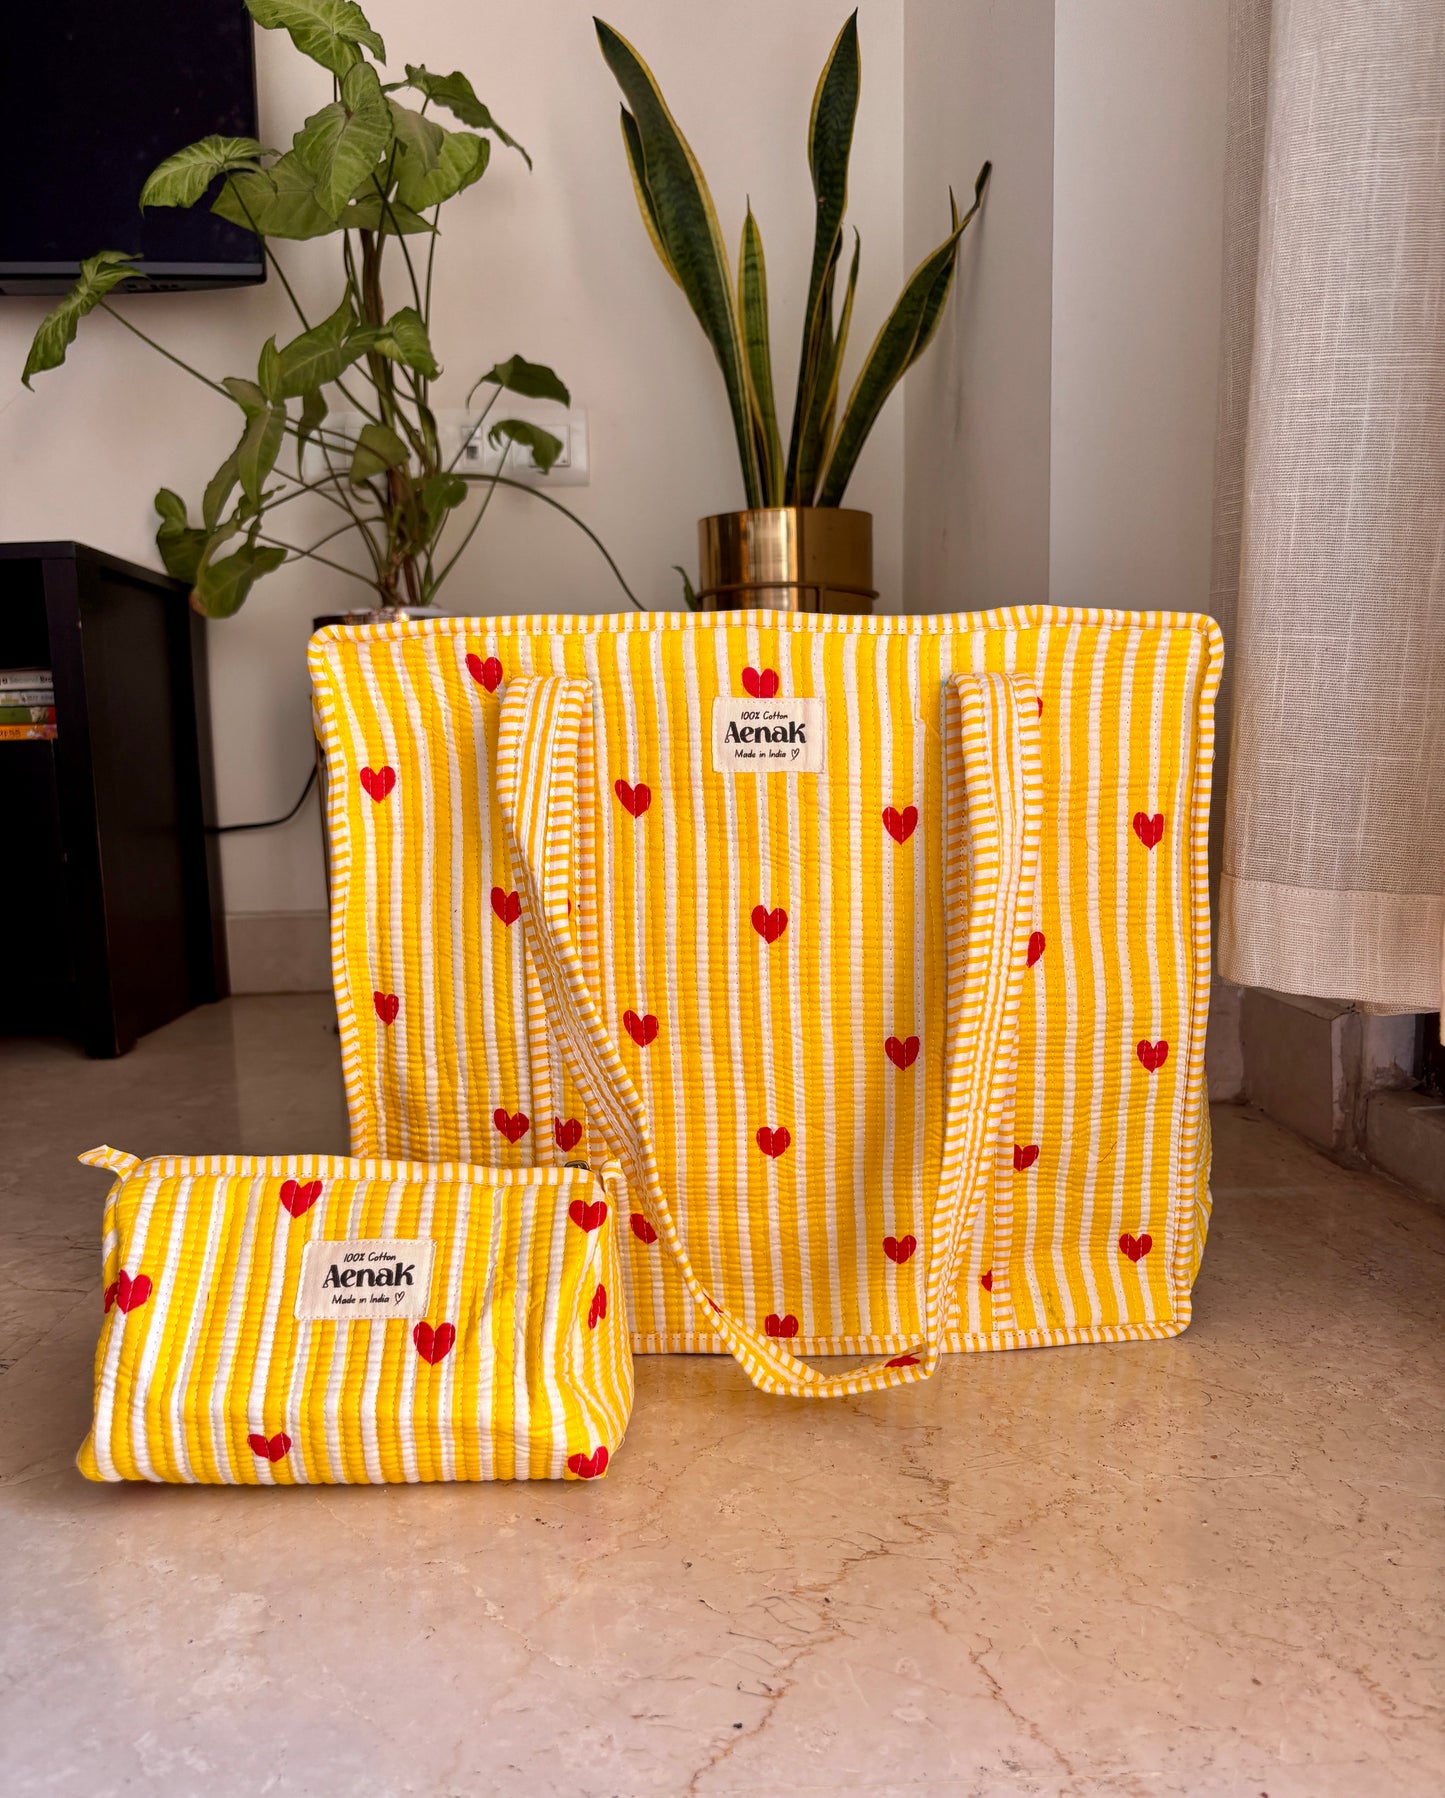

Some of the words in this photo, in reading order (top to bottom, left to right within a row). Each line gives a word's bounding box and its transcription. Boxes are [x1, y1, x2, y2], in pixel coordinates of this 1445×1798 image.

[763, 711, 788, 720] Cotton
[724, 721, 807, 743] Aenak
[734, 749, 756, 758] Made
[759, 750, 766, 758] in
[769, 749, 786, 758] India
[368, 1252, 396, 1262] Cotton
[322, 1262, 416, 1288] Aenak
[331, 1294, 356, 1304] Made
[359, 1296, 367, 1304] in
[370, 1293, 390, 1303] India
